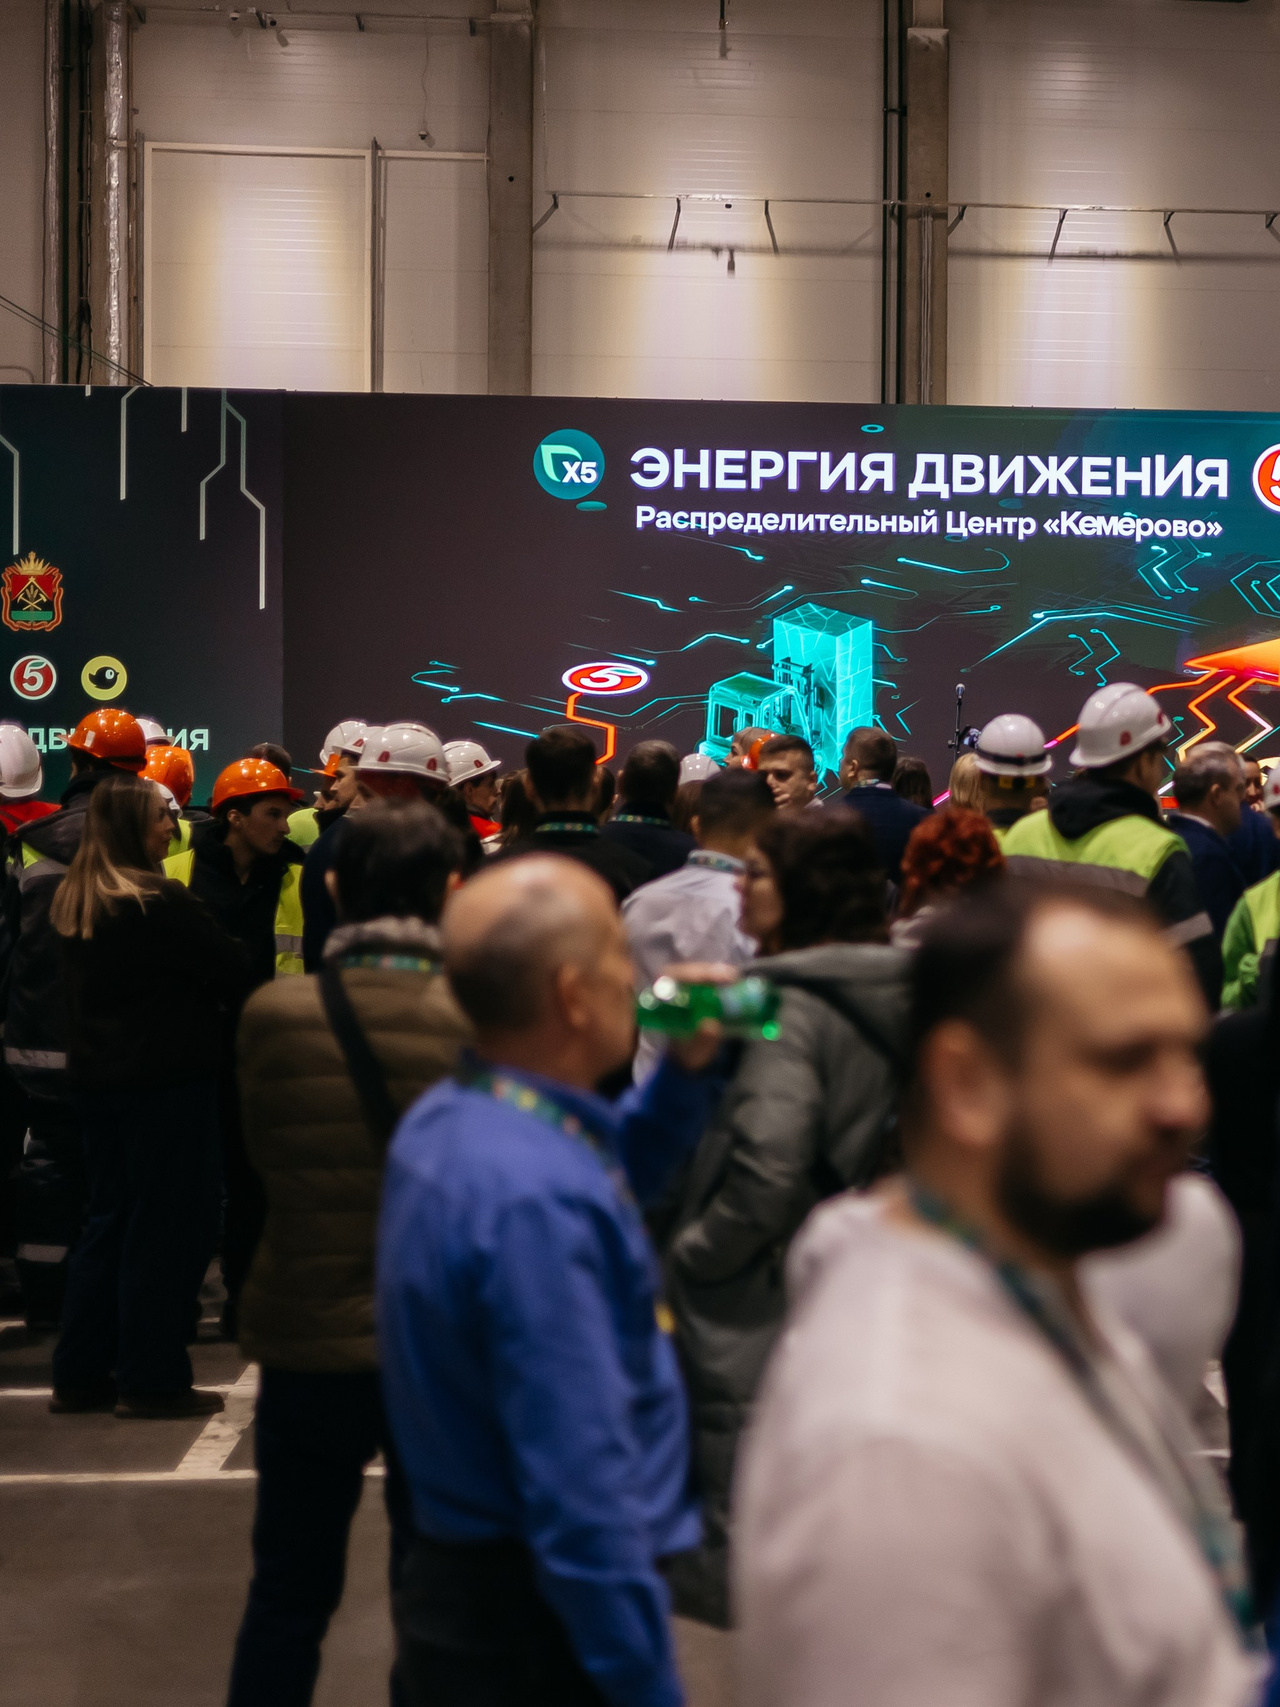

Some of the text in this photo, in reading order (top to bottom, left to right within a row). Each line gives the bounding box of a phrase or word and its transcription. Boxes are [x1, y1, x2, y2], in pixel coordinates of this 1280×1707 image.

[562, 461, 597, 484] X5
[630, 447, 1228, 499] ЭНЕРГИЯ ДВИЖЕНИЯ
[636, 505, 1223, 543] Распределительный Центр «Кемерово»
